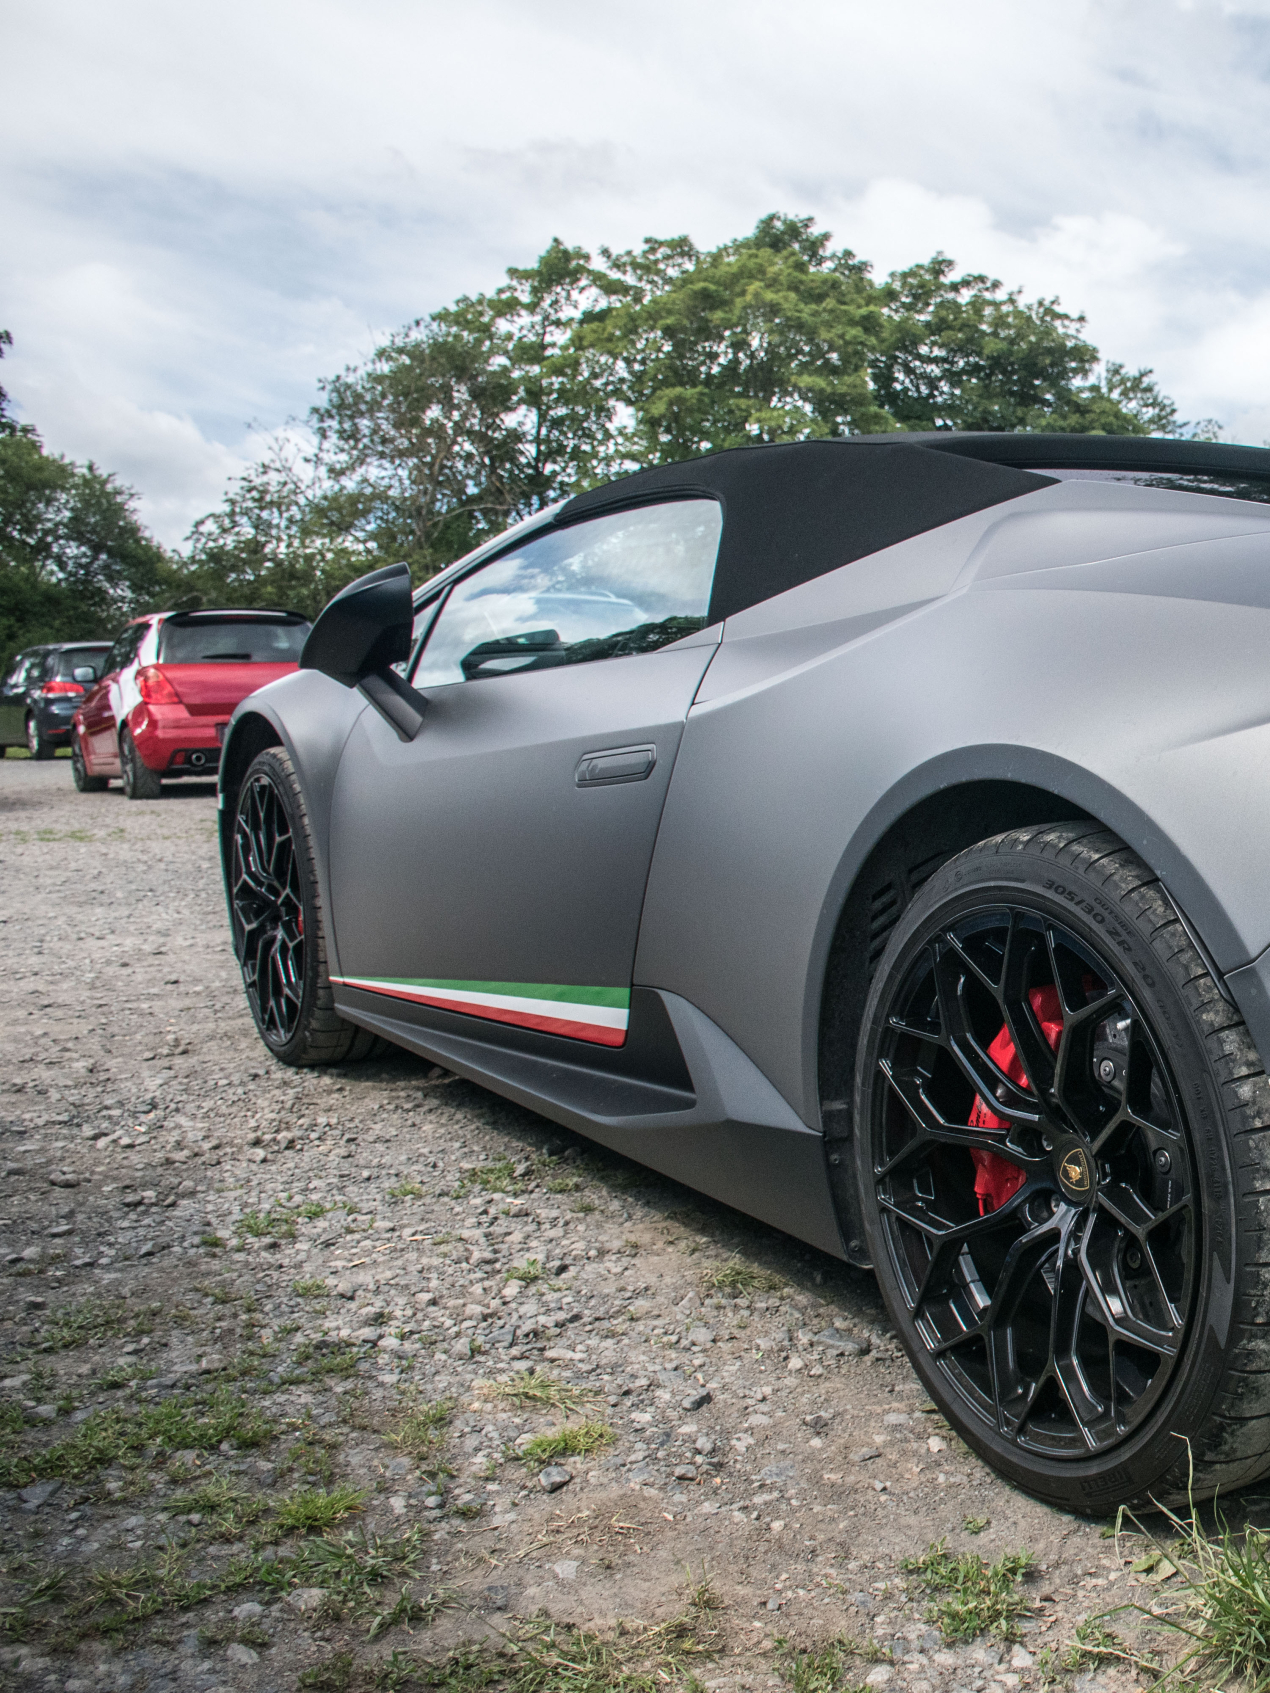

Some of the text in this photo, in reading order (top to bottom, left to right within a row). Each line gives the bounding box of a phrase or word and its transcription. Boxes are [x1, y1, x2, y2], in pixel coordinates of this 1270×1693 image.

[1042, 879, 1106, 925] 305/30
[1105, 926, 1133, 953] ZR
[1132, 960, 1156, 989] 20
[1093, 897, 1138, 938] OUTSIDE
